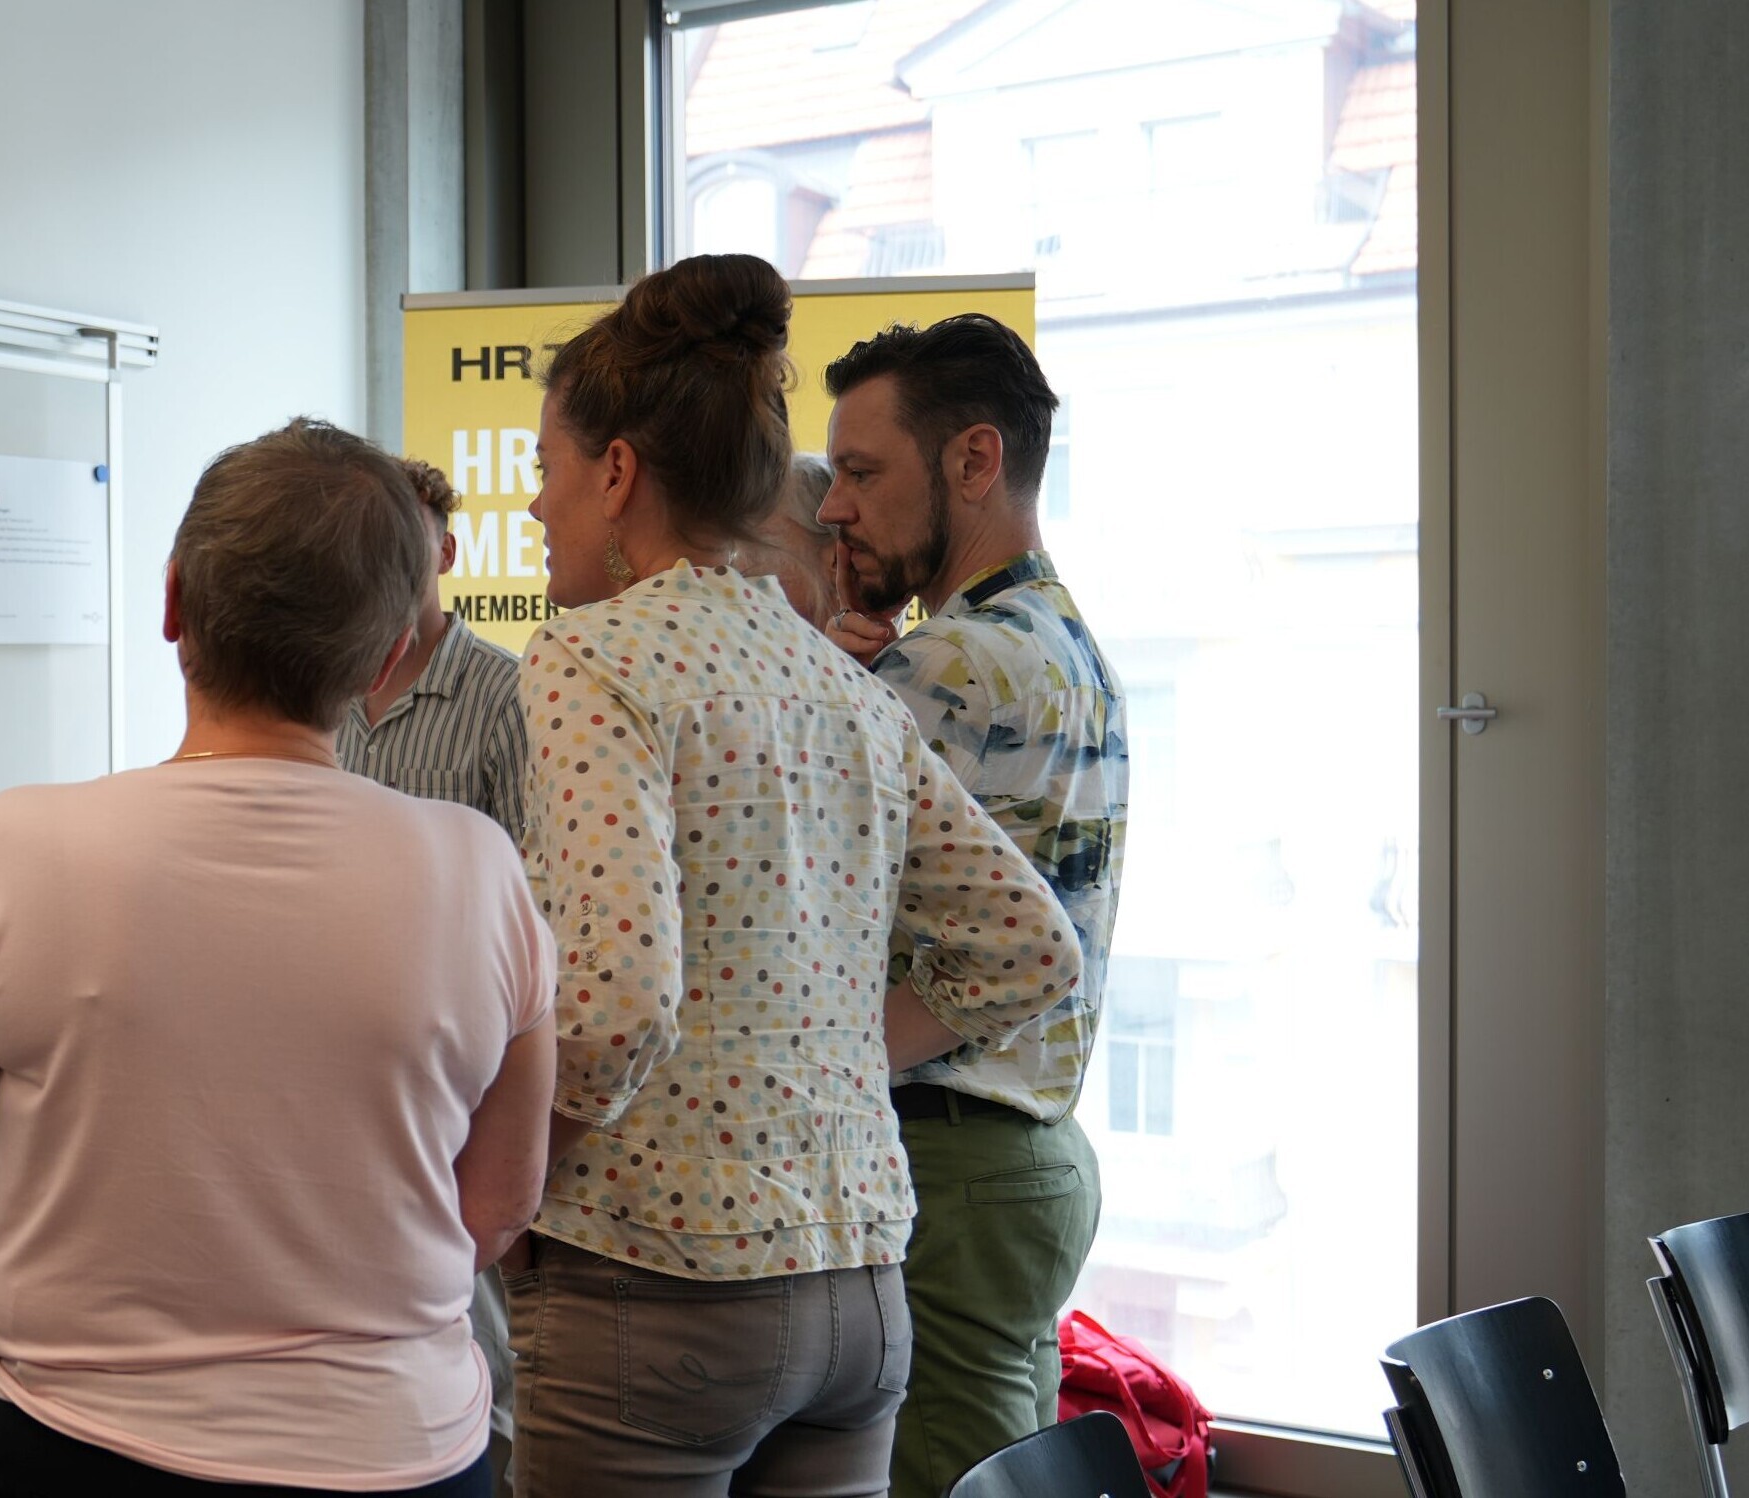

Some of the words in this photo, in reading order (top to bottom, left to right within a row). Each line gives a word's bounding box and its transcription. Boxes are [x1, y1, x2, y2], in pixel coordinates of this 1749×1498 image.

[452, 345, 532, 381] HR
[453, 428, 539, 496] HR
[453, 510, 552, 578] ME
